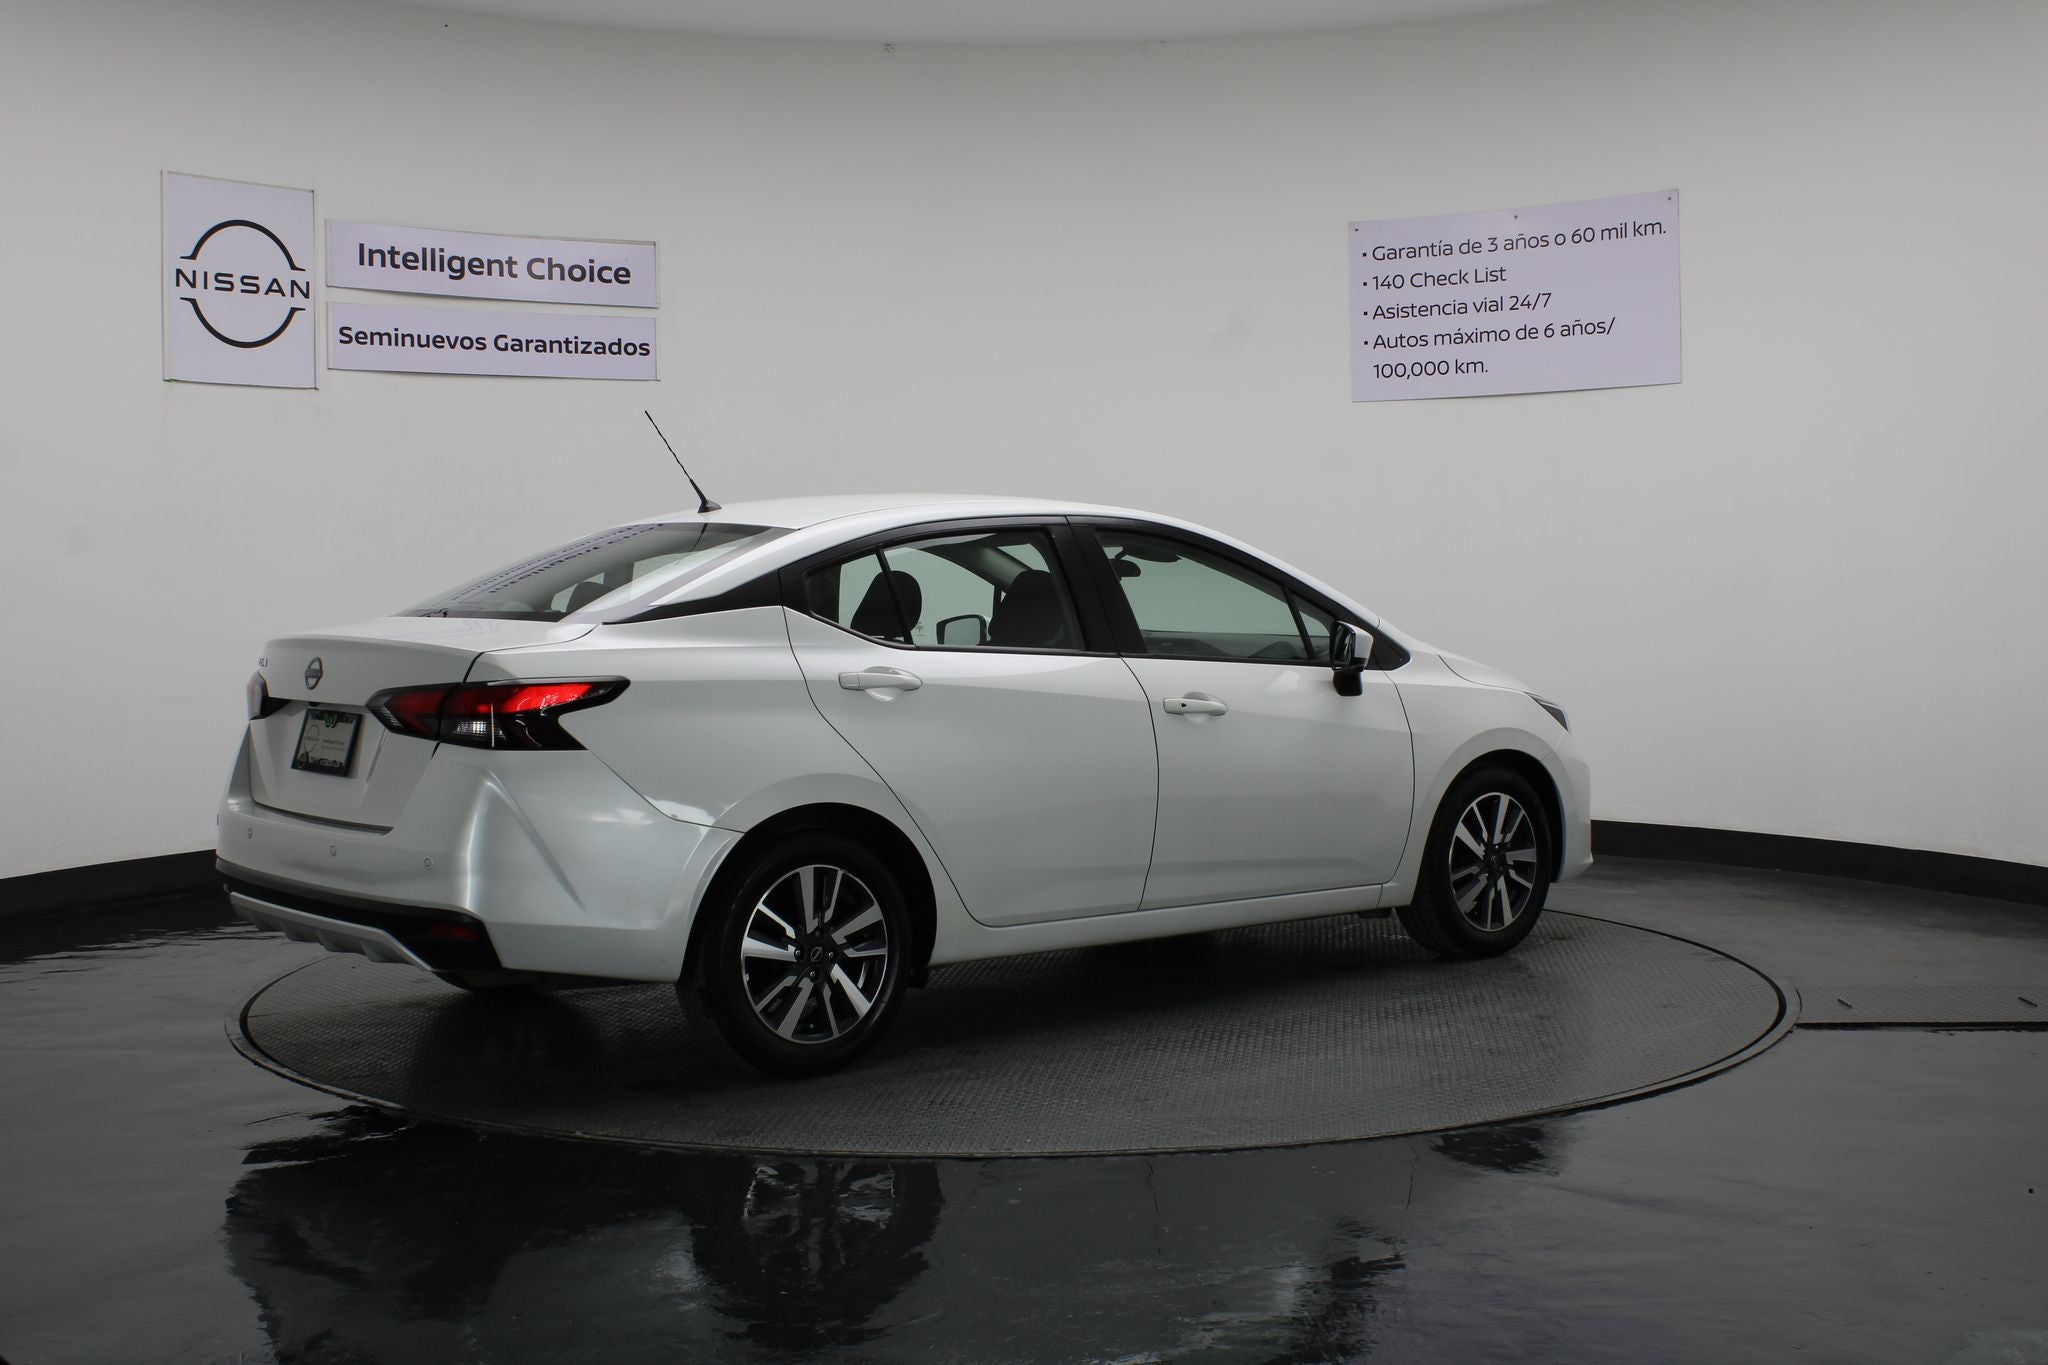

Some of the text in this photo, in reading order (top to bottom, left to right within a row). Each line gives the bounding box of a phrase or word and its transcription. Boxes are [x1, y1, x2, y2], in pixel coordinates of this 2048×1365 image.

[1372, 220, 1667, 261] Garantía de 3 años o 60 mil km.
[359, 243, 632, 285] Intelligent Choice
[1372, 266, 1507, 290] 140 Check List
[175, 268, 310, 299] NISSAN
[1372, 292, 1552, 320] Asistencia vial 24/7
[338, 326, 651, 357] Seminuevos Garantizados
[1372, 316, 1616, 350] Autos máximo de 6 años/
[1373, 358, 1489, 380] 100,000 km.
